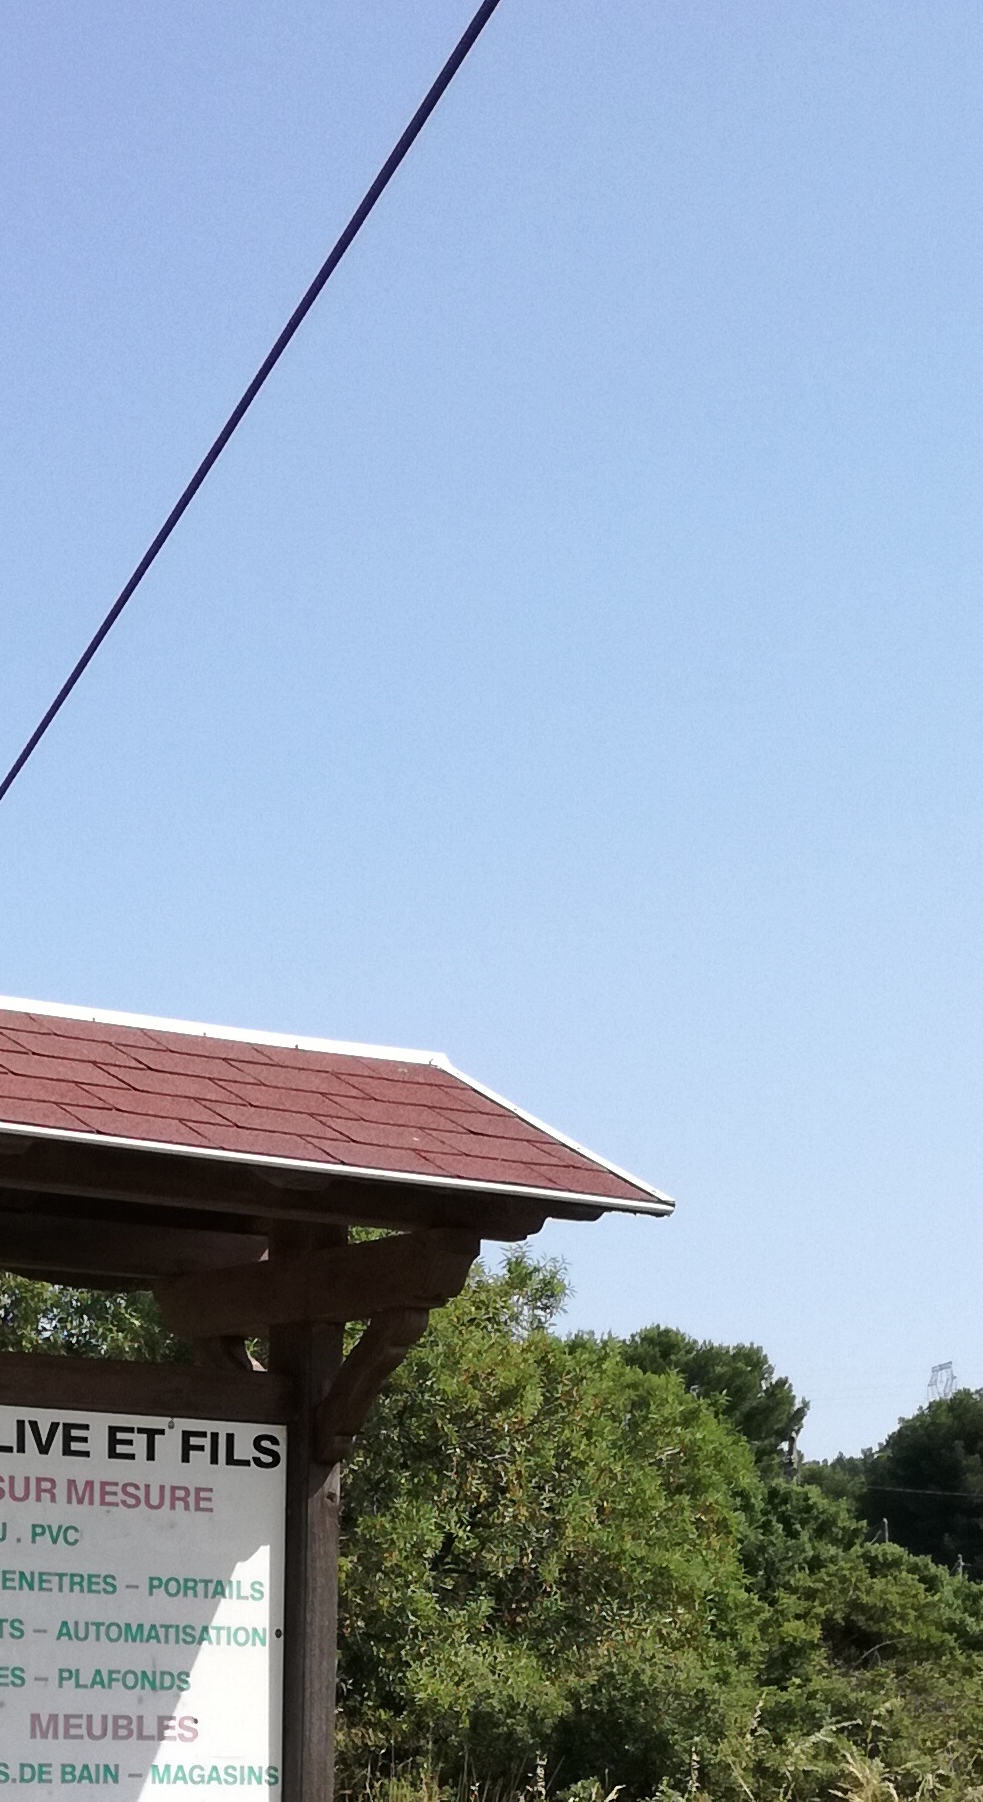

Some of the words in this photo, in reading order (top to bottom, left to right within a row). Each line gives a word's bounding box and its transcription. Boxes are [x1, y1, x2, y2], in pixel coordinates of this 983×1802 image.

[108, 1425, 165, 1461] ET
[181, 1430, 281, 1469] FILS
[67, 1479, 213, 1513] MESURE
[31, 1524, 79, 1546] PVC
[149, 1575, 264, 1602] PORTAILS
[56, 1620, 266, 1648] AUTOMATISATION
[58, 1667, 192, 1693] PLAFONDS
[30, 1712, 199, 1743] MEUBLES
[61, 1764, 119, 1784] BAIN
[151, 1763, 279, 1787] MAGASINS
